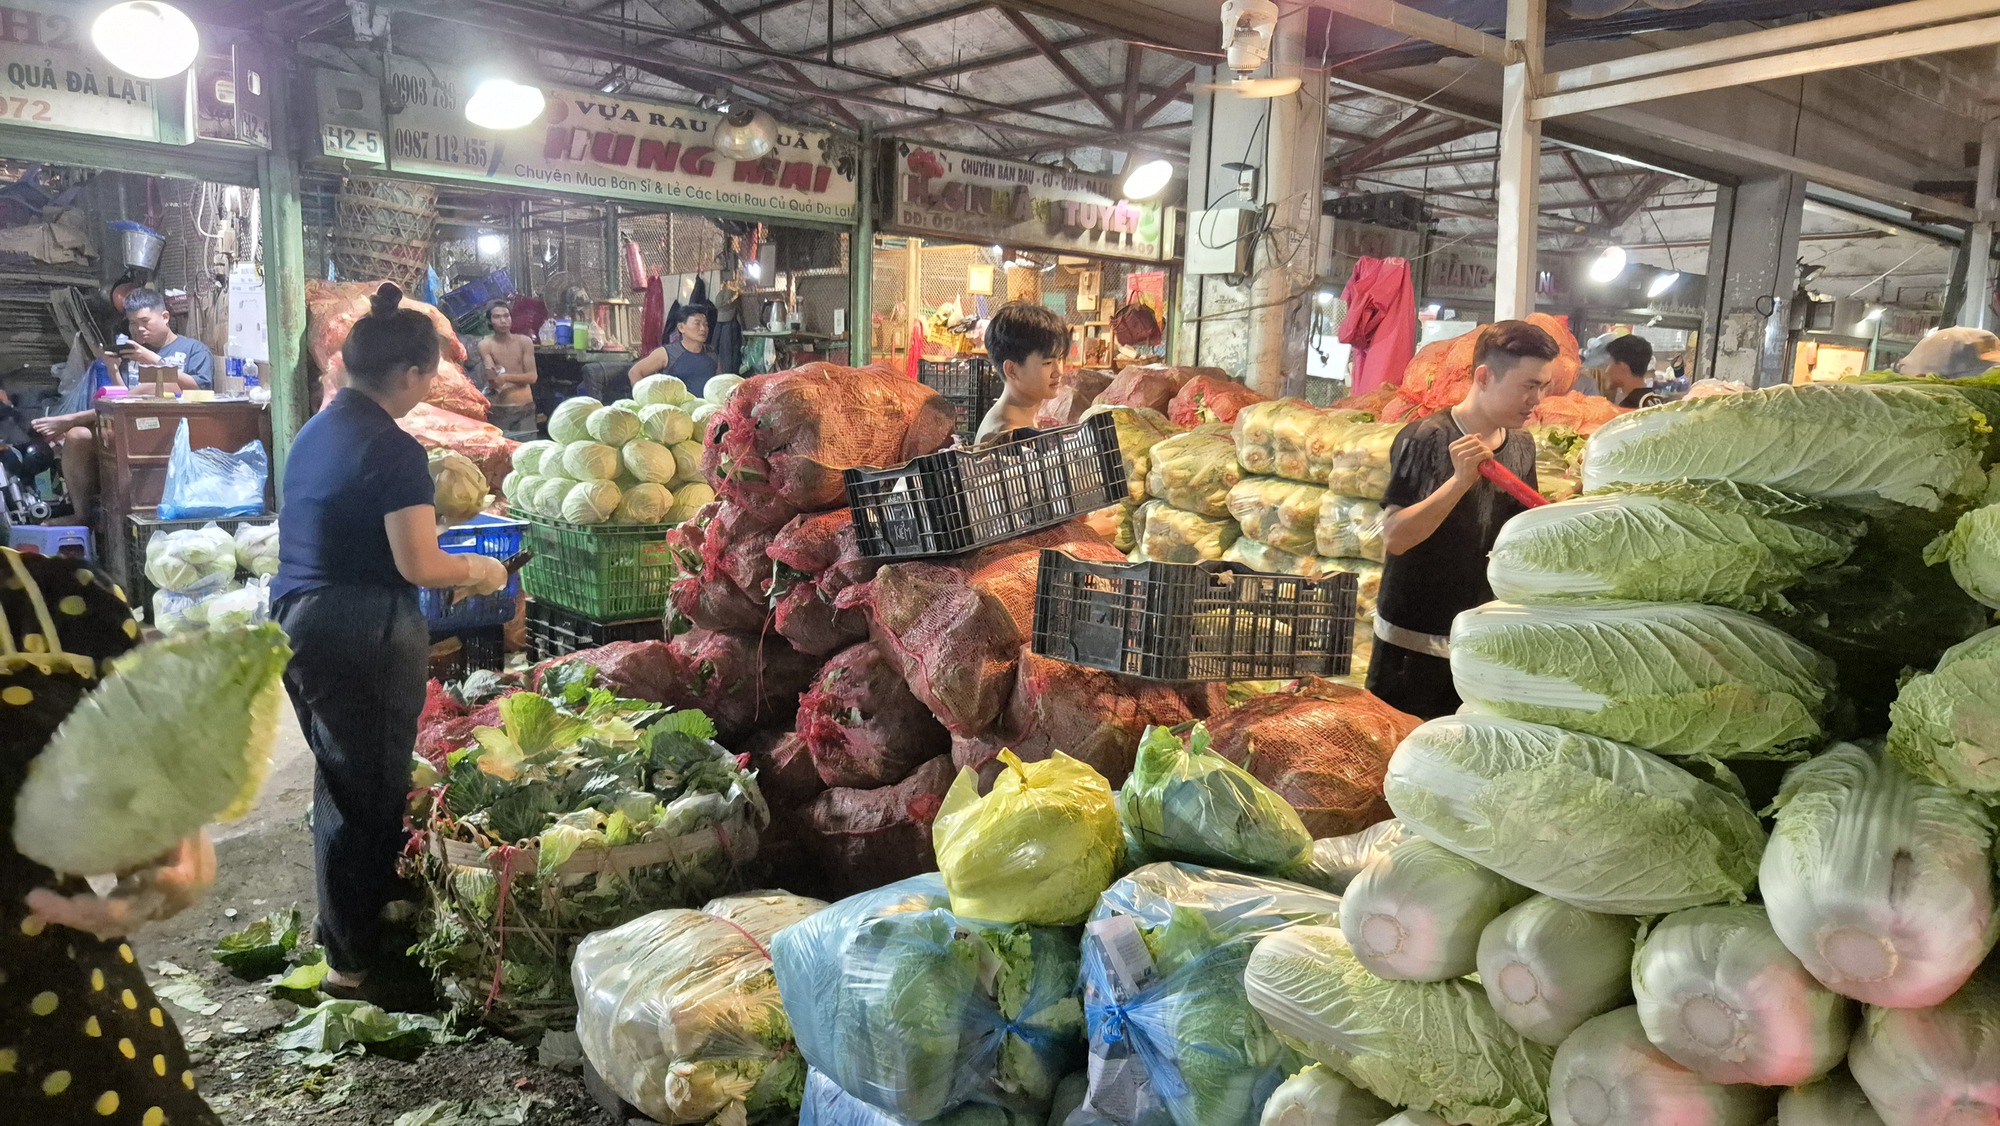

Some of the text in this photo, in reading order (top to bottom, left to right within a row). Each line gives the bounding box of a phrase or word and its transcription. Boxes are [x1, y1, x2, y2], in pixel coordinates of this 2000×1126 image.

[7, 59, 150, 104] QUẢ ĐÀ LẠT
[325, 126, 378, 153] H2-5
[575, 101, 809, 150] VỰA RAU UẢ
[395, 128, 488, 167] 0987 112 455
[514, 163, 571, 184] Chuyên
[576, 171, 606, 188] Mua
[611, 175, 637, 192] Bán
[655, 181, 663, 195] &
[667, 180, 681, 197] Lẻ
[685, 185, 712, 201] Các
[716, 190, 741, 207] Loại
[744, 193, 766, 208] Rau
[769, 195, 786, 210] Củ
[789, 198, 812, 214] Quả
[998, 163, 1016, 183] BÁN
[1018, 168, 1035, 185] RAU
